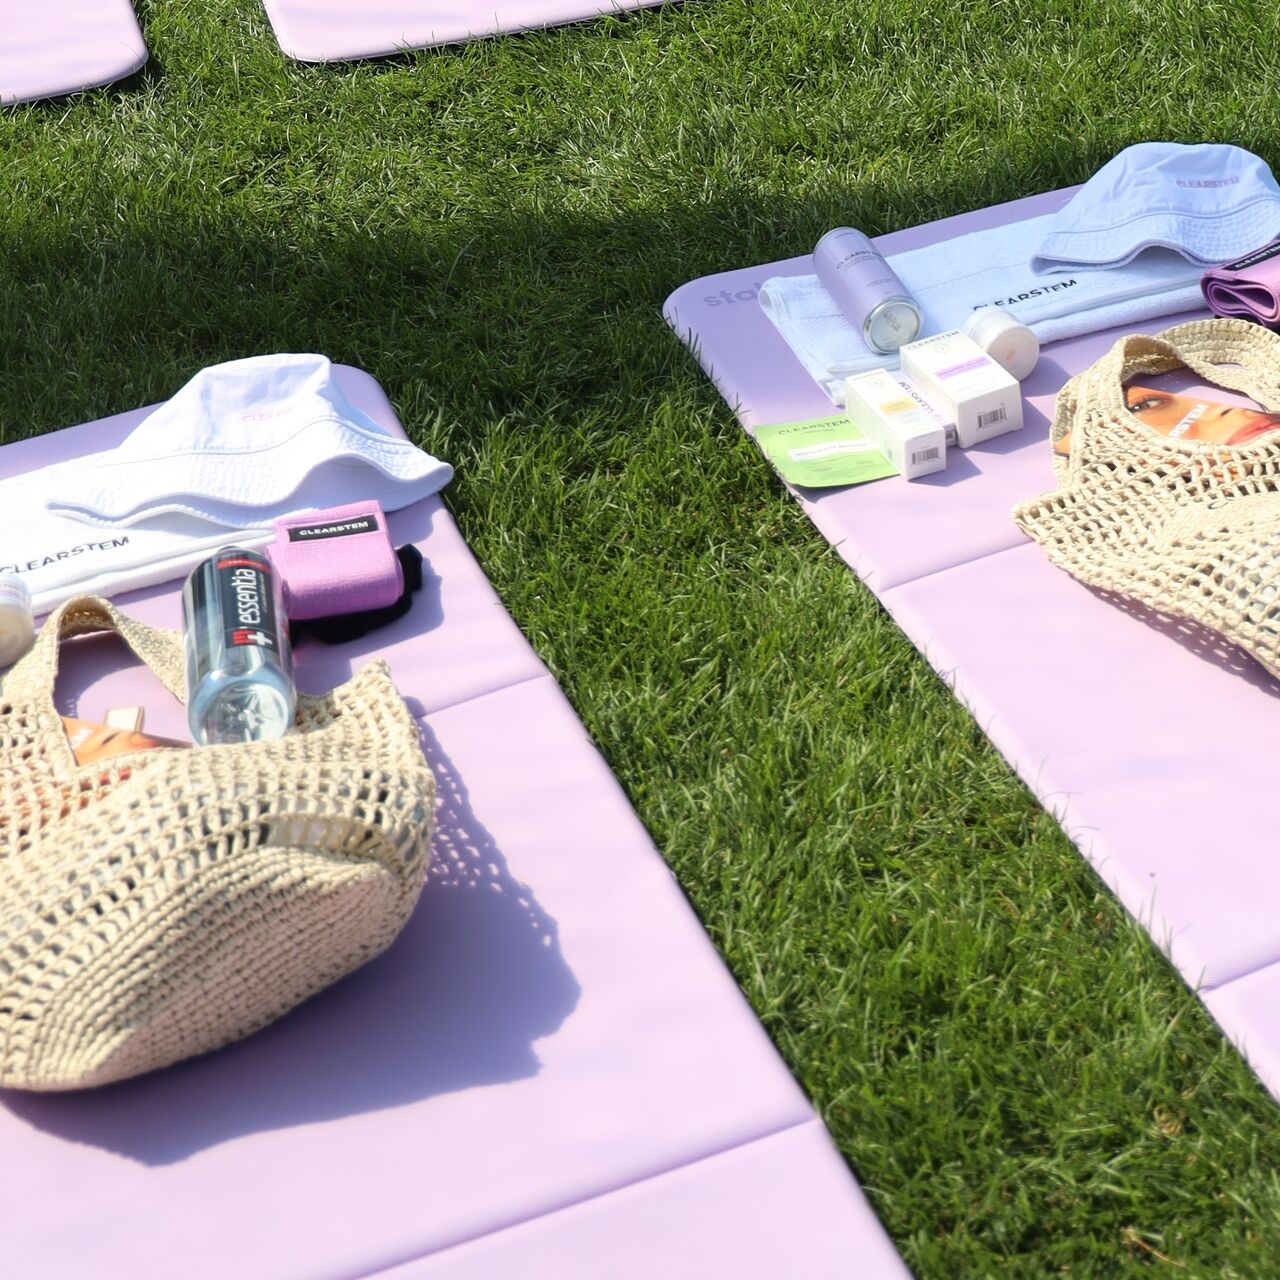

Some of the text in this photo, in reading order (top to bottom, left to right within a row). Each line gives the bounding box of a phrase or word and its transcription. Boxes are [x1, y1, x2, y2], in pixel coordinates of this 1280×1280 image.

[1168, 403, 1209, 438] RSTEM
[299, 521, 369, 536] CLEARSTEM
[230, 568, 262, 625] essentia
